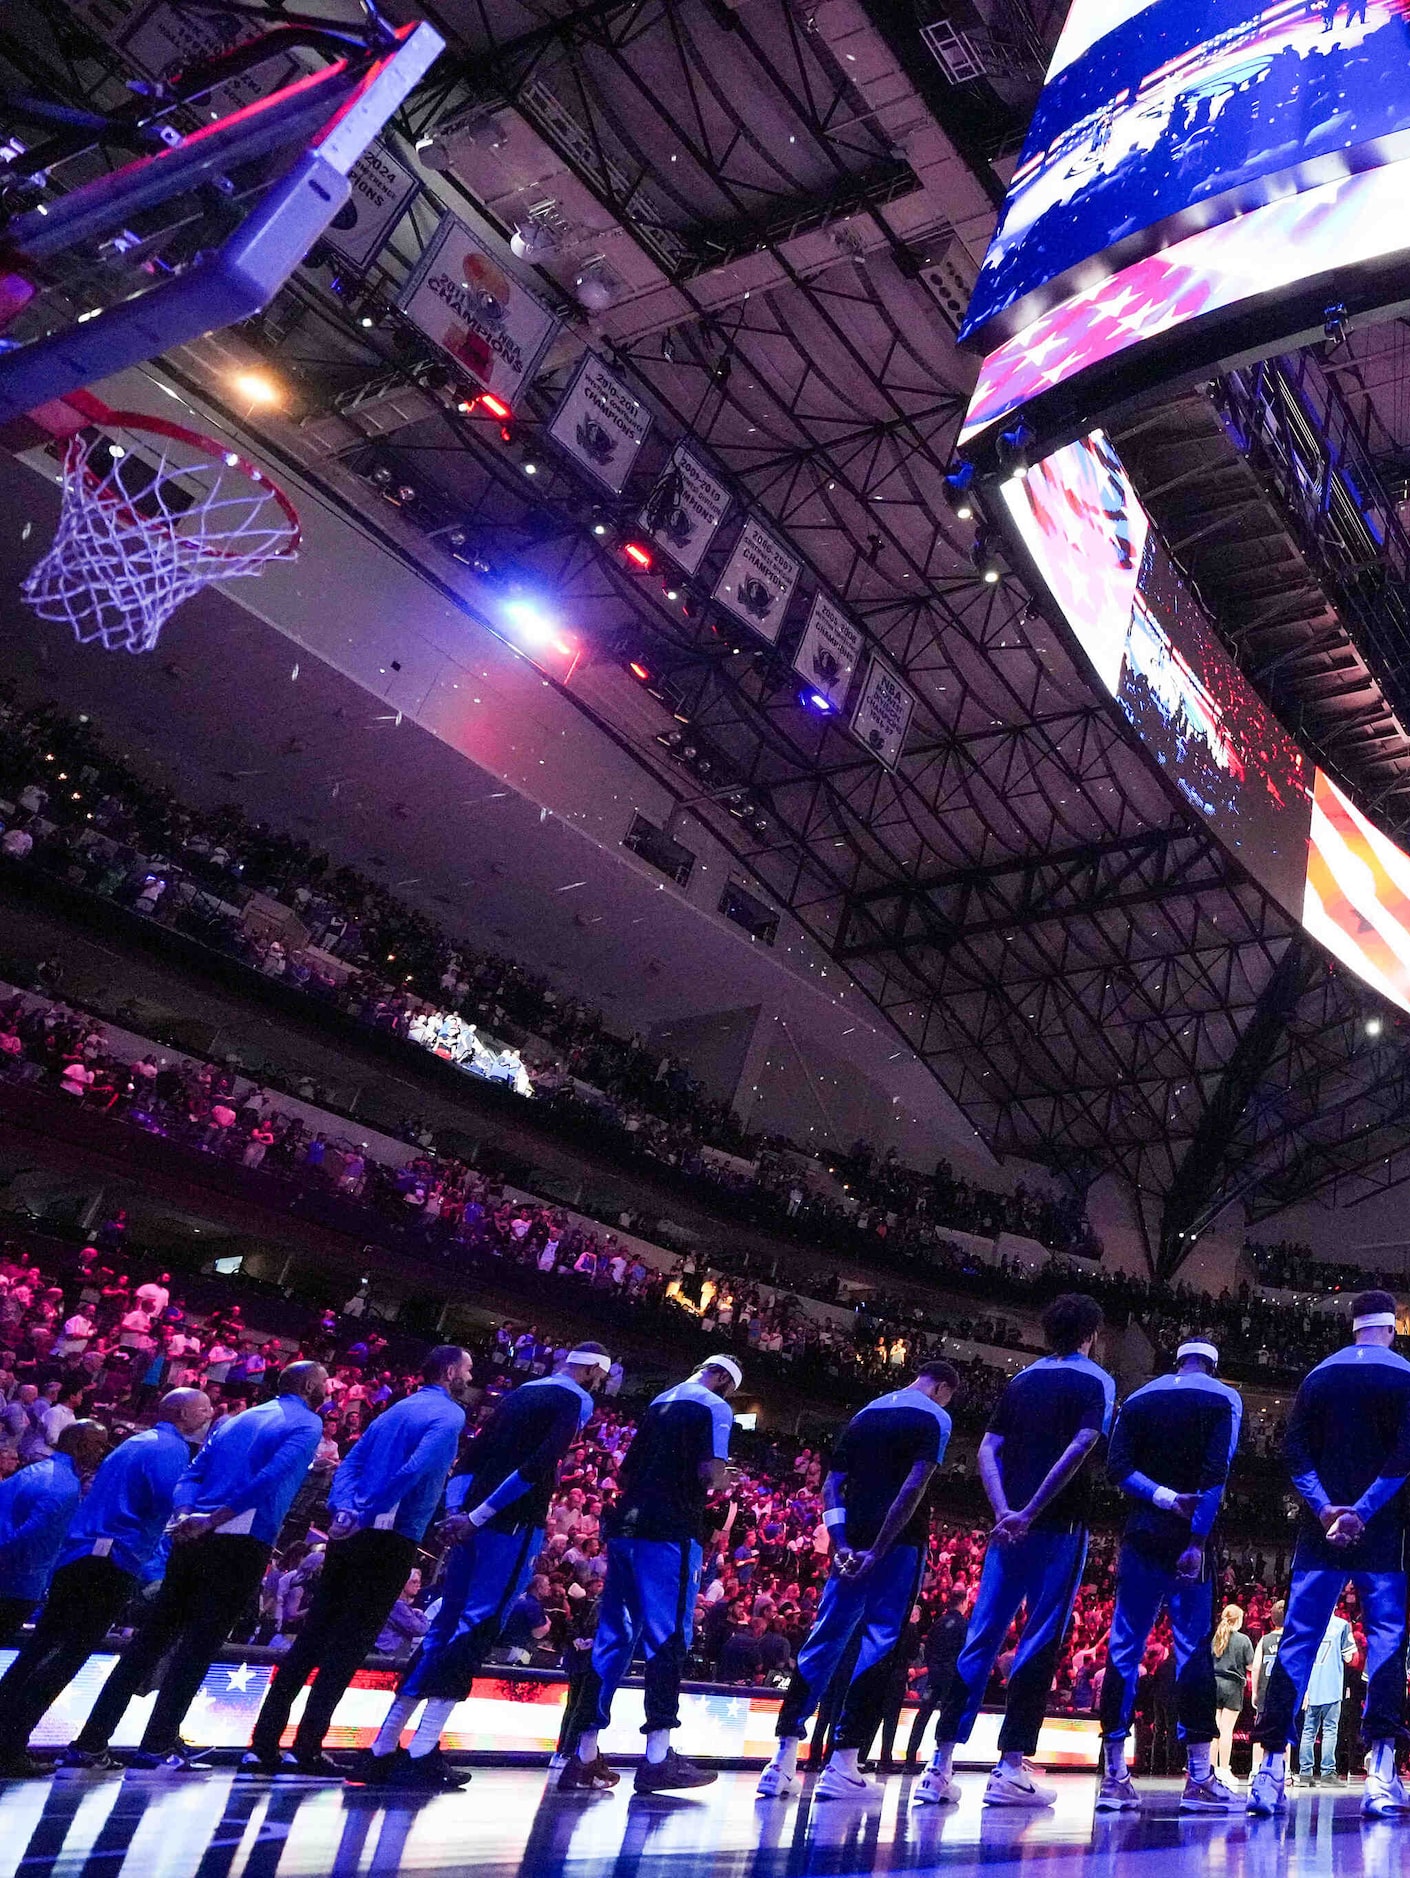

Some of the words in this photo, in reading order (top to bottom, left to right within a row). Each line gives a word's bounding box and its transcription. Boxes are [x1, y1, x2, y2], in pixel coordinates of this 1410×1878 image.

[427, 278, 523, 374] CHAMPIONS
[584, 387, 635, 440] CHAMPIONS
[682, 488, 716, 525] MPIONS
[743, 548, 788, 594] CHAMPIONS
[881, 676, 900, 703] NBA
